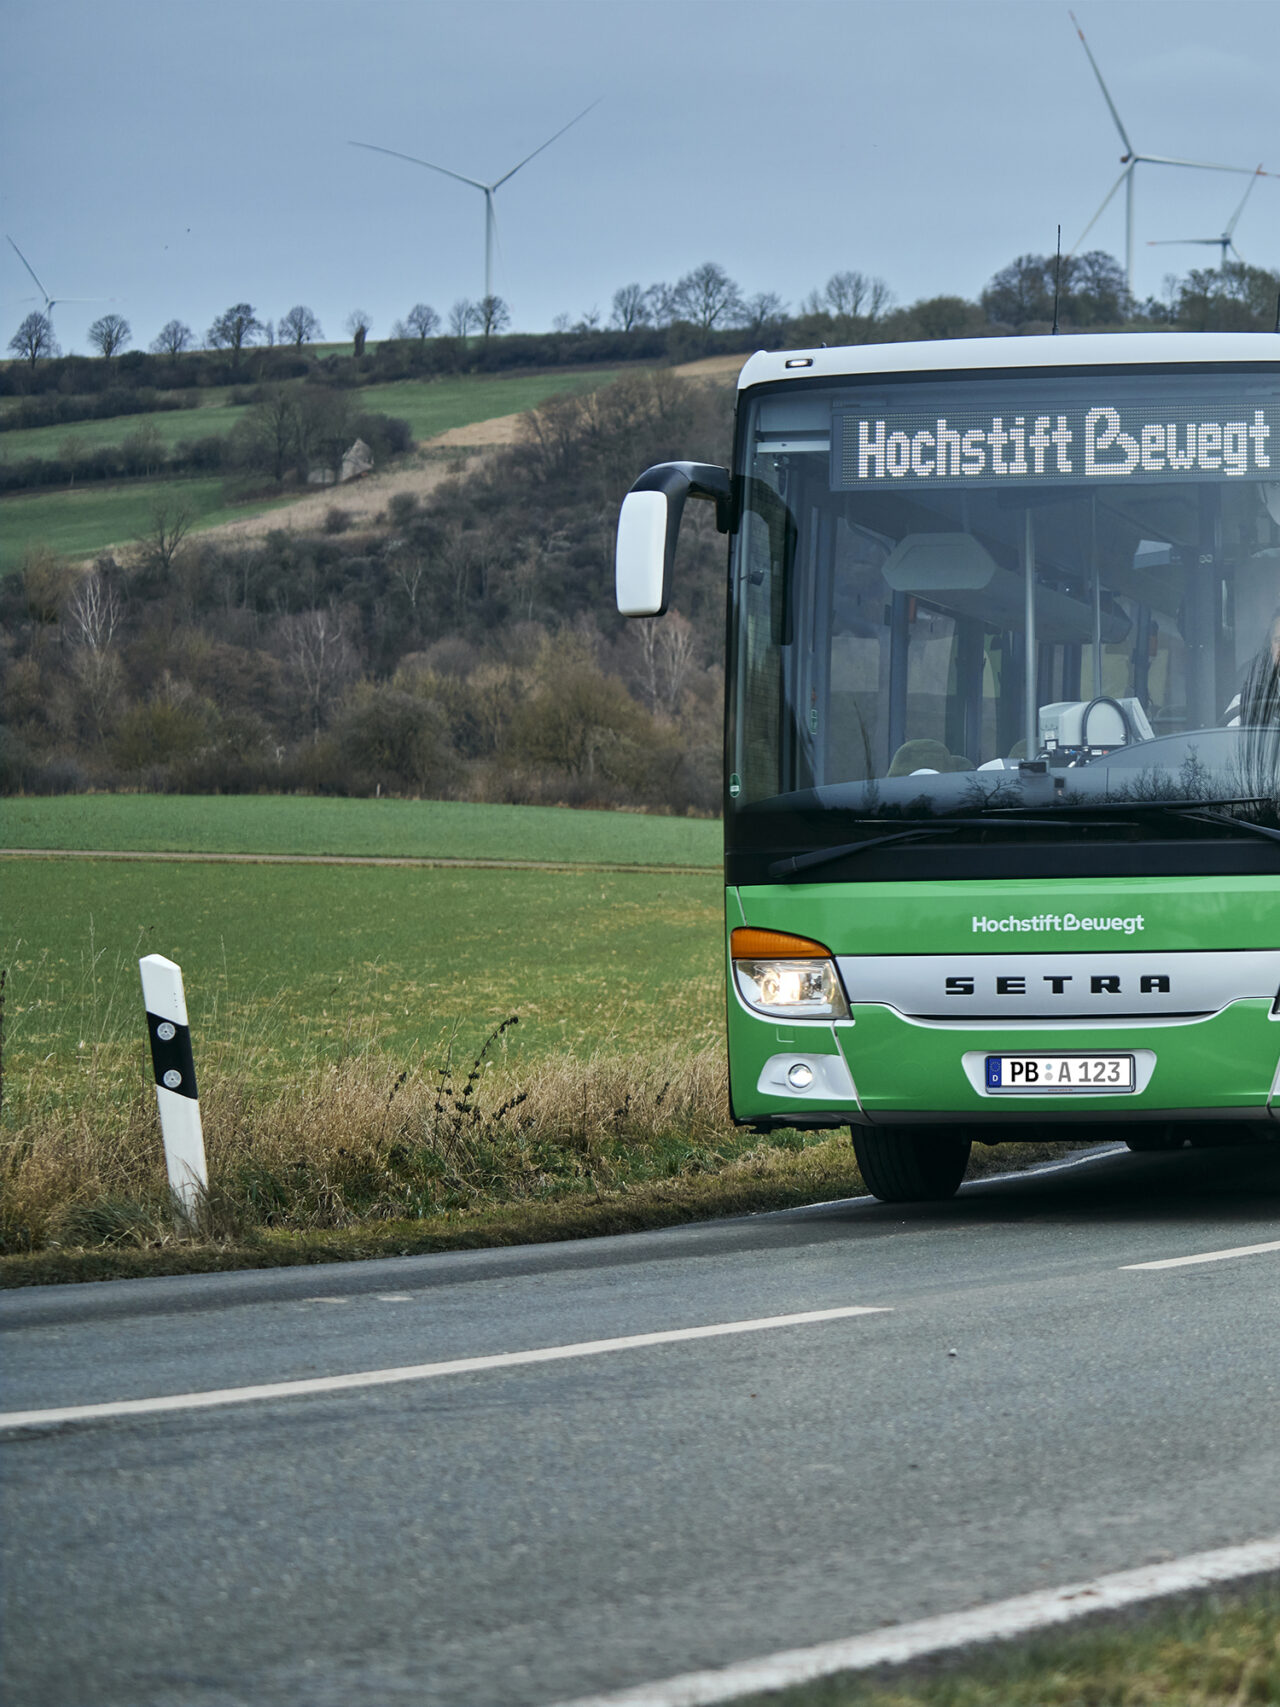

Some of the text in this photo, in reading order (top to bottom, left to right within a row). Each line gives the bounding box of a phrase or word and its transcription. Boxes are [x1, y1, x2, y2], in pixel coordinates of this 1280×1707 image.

[858, 407, 1271, 478] Hochstift Bewegt
[945, 975, 1171, 995] SETRA
[992, 1074, 999, 1083] D
[1010, 1061, 1121, 1083] PB A 123
